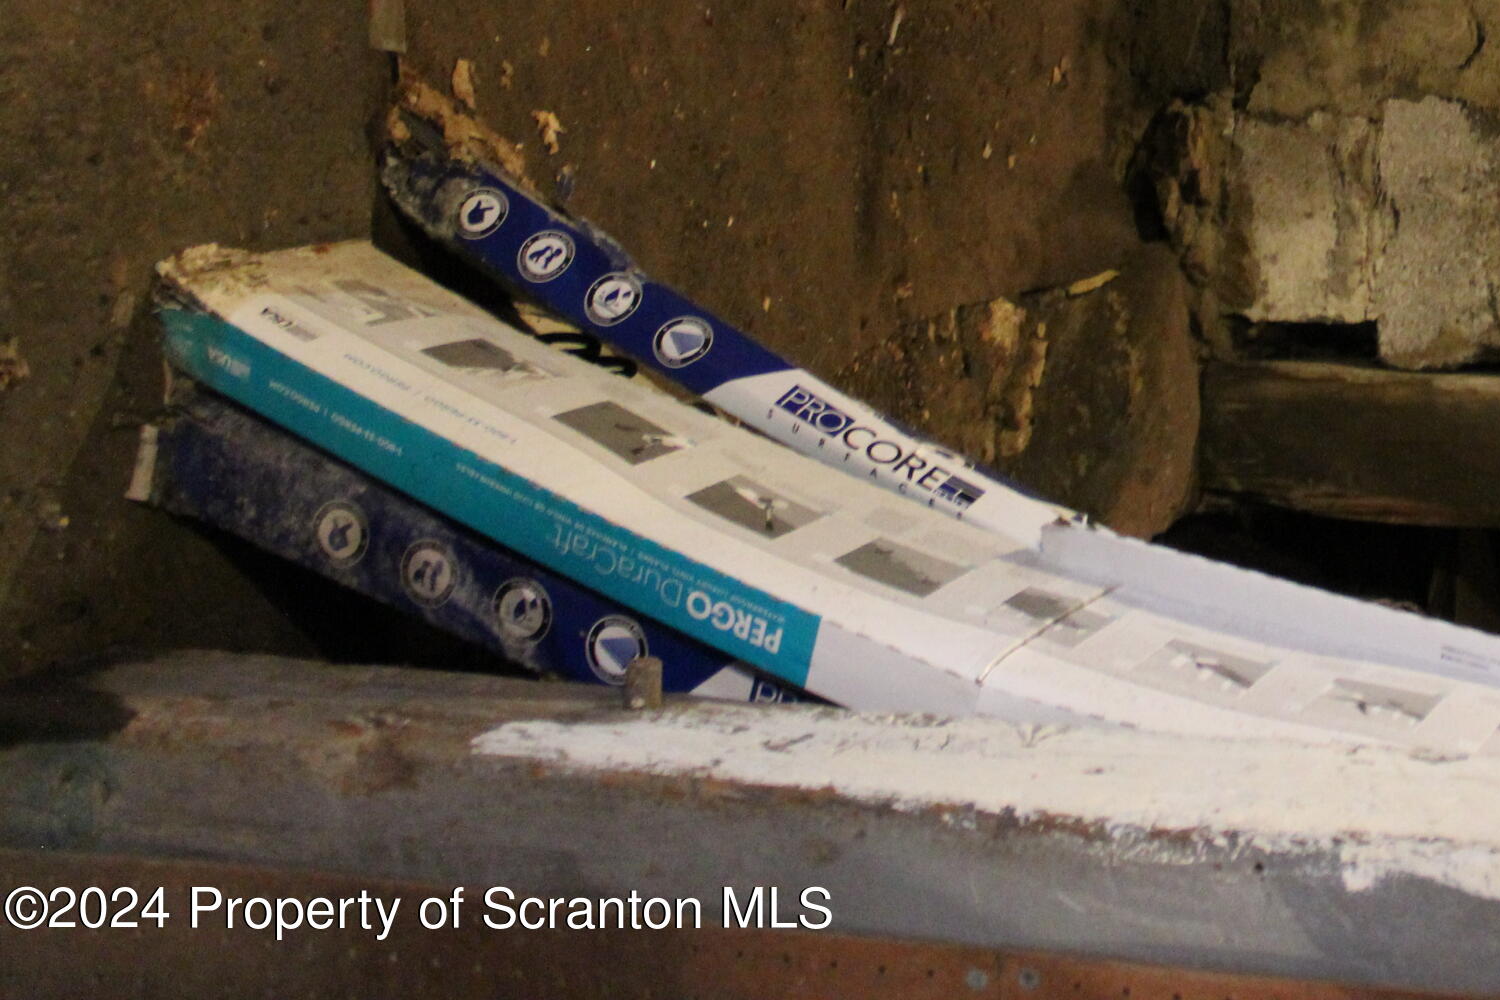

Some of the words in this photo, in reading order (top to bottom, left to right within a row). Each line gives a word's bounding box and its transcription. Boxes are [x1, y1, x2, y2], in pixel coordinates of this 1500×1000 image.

[778, 386, 950, 491] PROCORE
[553, 524, 683, 608] DuraCraft
[686, 591, 784, 655] PERGO
